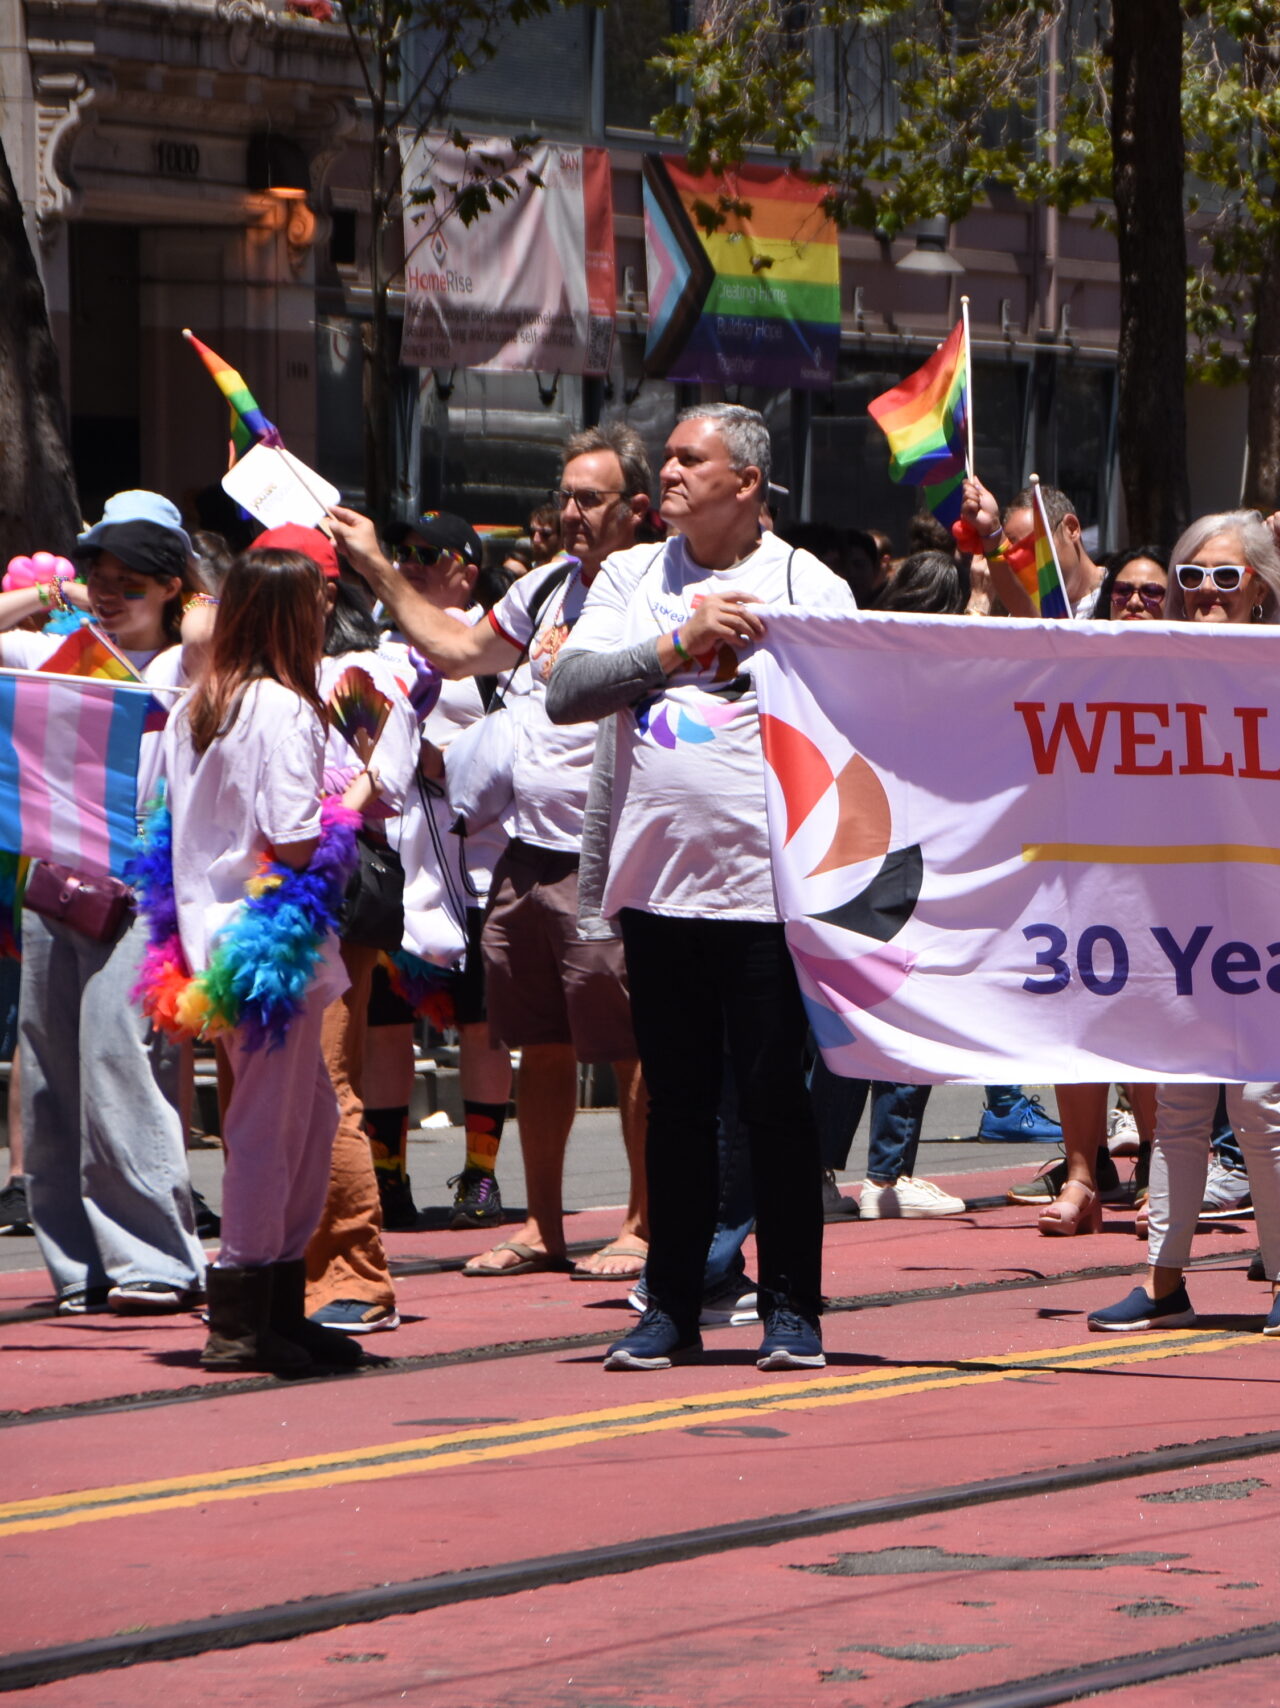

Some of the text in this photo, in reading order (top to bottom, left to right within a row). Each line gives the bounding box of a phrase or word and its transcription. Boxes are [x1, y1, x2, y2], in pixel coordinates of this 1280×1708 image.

[560, 152, 579, 170] SAN
[408, 266, 473, 293] HomeRise
[1021, 923, 1130, 997] 30
